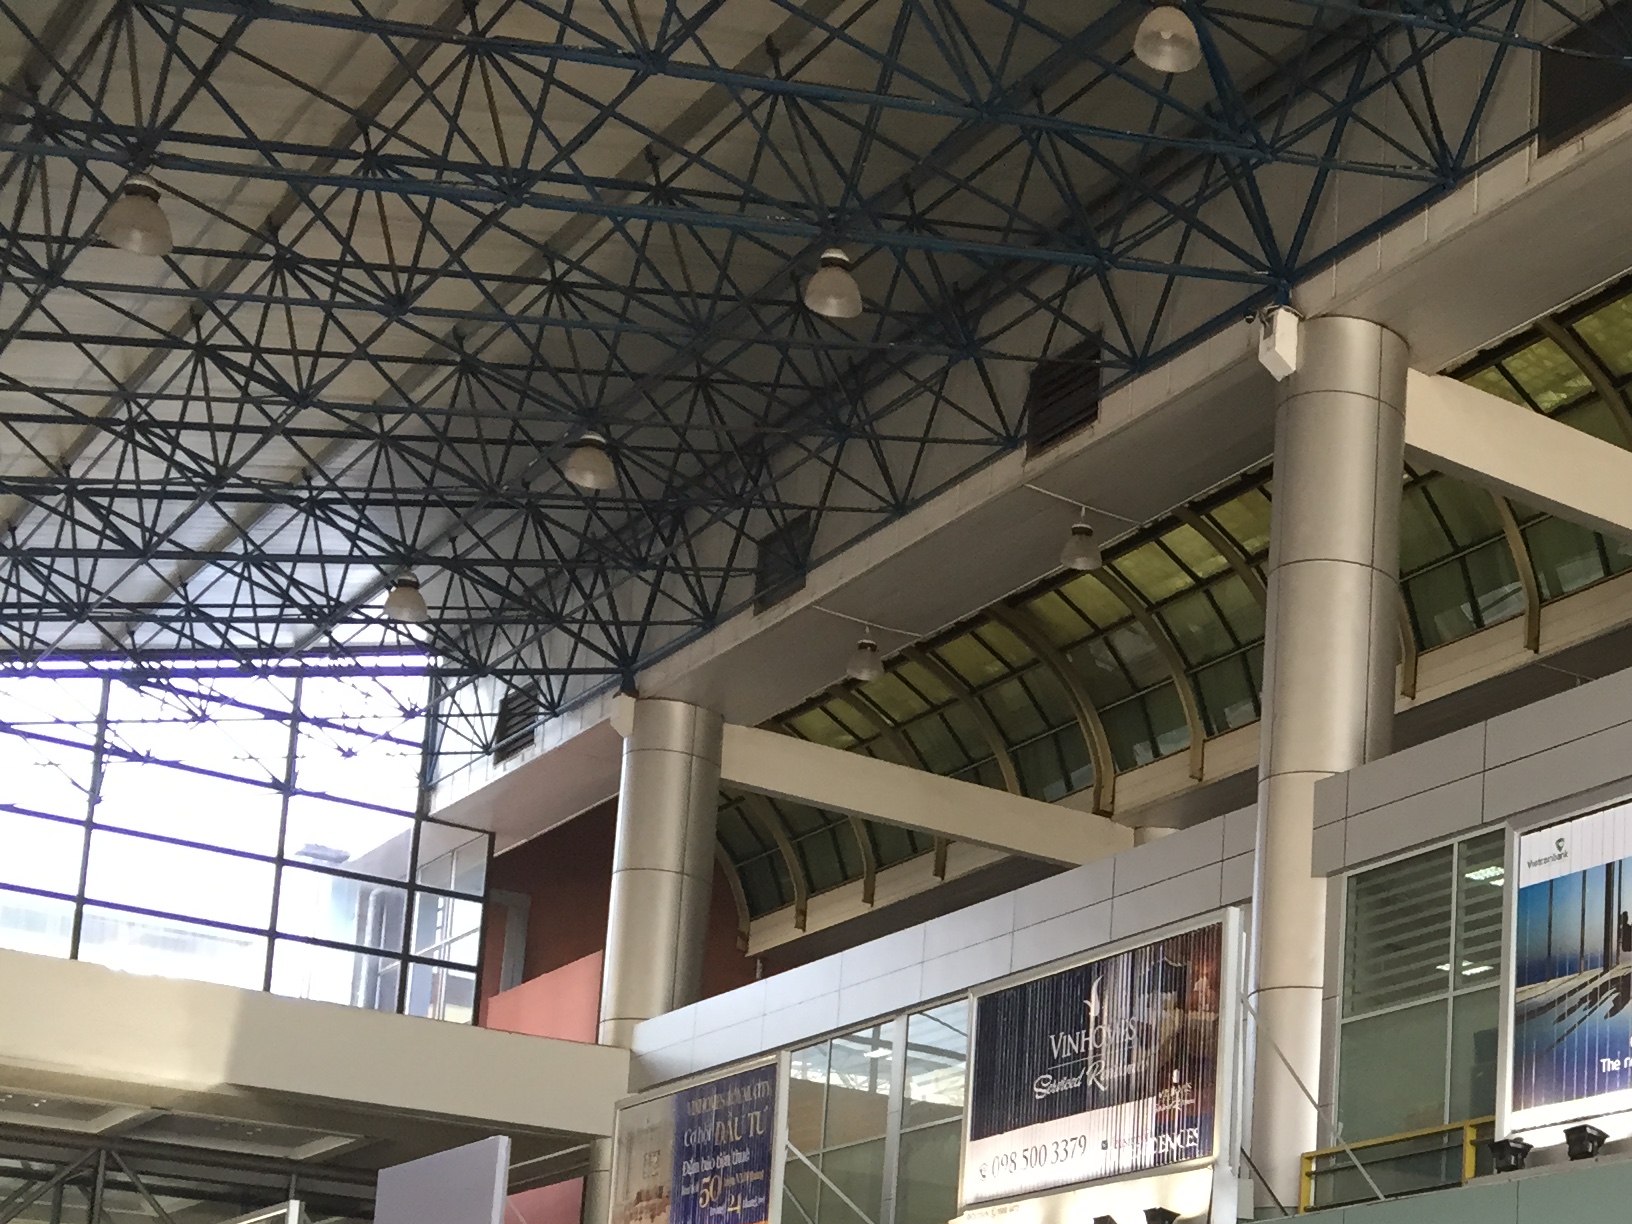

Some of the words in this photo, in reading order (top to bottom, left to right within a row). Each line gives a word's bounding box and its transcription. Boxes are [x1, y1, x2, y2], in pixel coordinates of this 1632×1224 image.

[1601, 1057, 1621, 1073] The
[1022, 1144, 1048, 1172] 500
[1050, 1134, 1087, 1165] 3379
